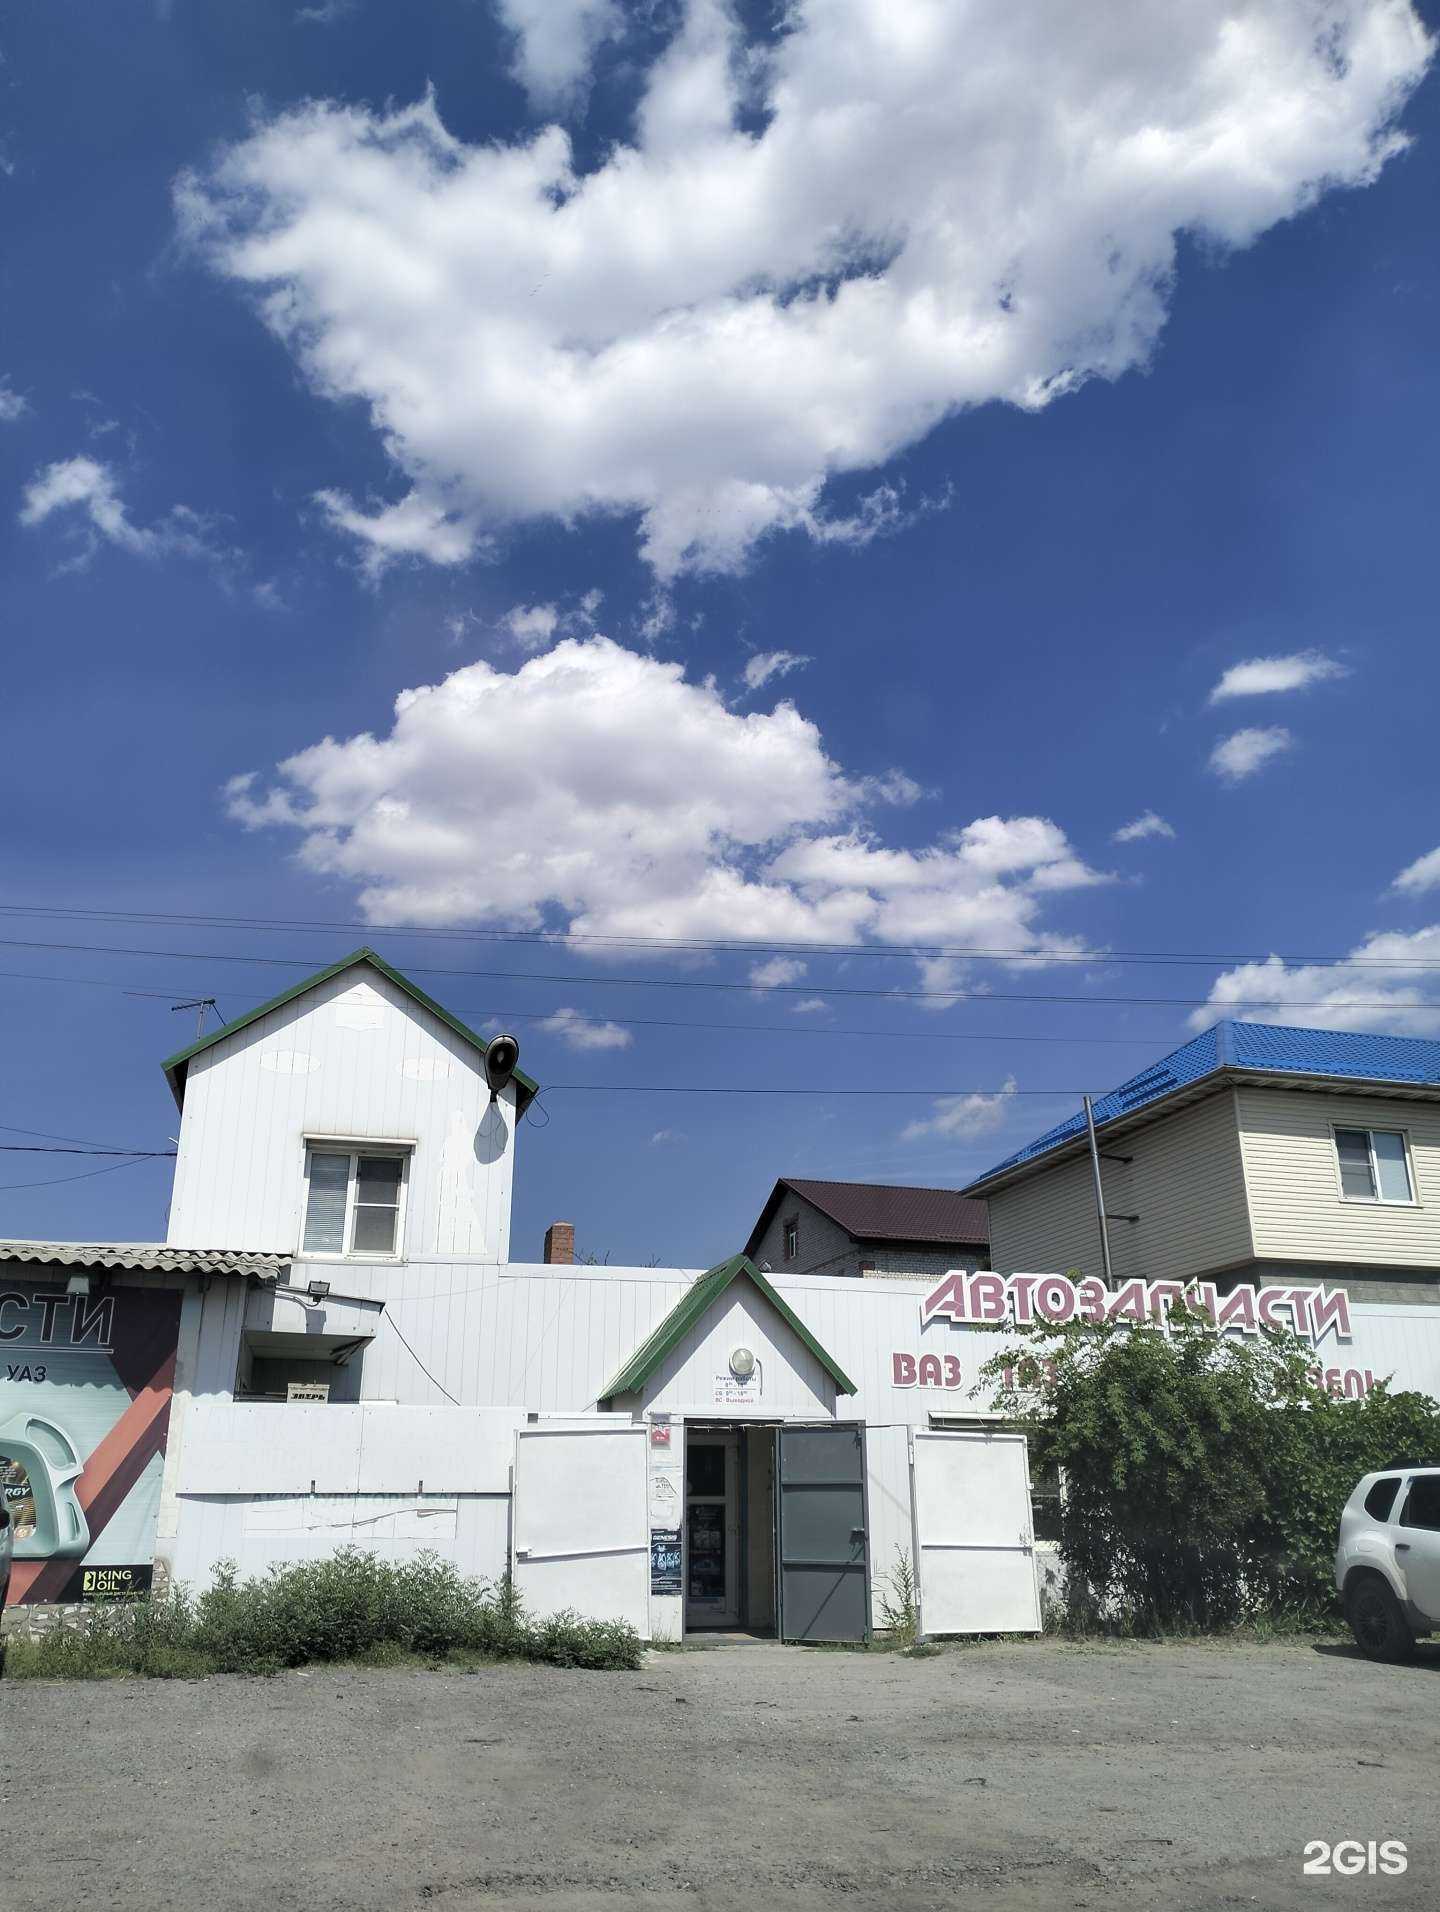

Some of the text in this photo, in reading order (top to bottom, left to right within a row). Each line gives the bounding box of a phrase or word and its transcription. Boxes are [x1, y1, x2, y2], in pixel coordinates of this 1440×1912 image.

[922, 1271, 1351, 1338] АВТОЗАПЧАСТИ
[7, 1364, 47, 1382] УАЗ
[892, 1352, 962, 1388] ВАЗ
[98, 1570, 132, 1580] KING
[97, 1580, 120, 1591] OIL
